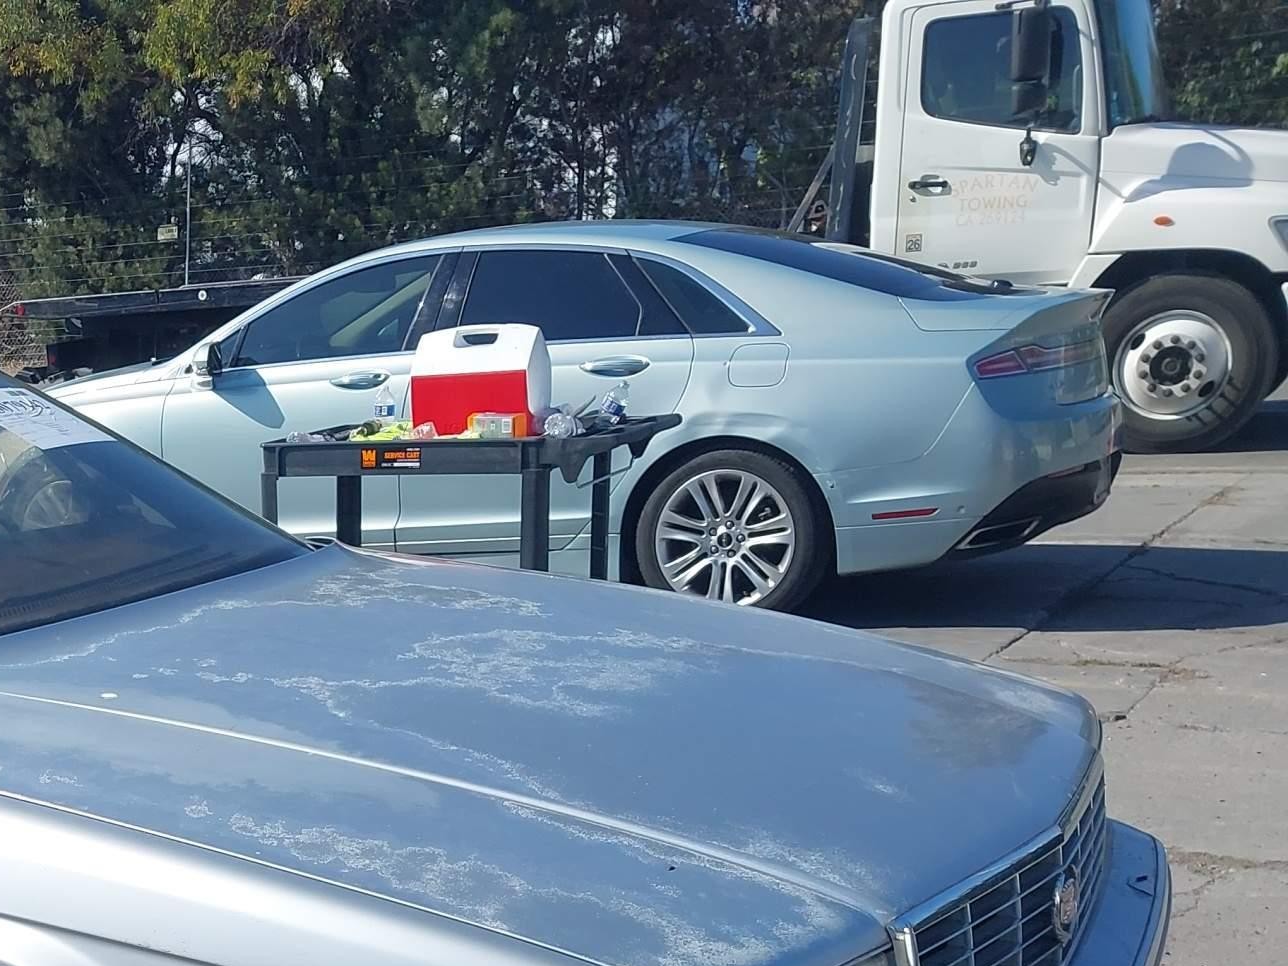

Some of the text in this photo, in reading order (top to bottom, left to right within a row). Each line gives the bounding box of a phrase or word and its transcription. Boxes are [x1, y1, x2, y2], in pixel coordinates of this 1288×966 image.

[952, 175, 1039, 198] SPARTAN
[959, 194, 1028, 212] TOWING
[907, 239, 920, 250] 26
